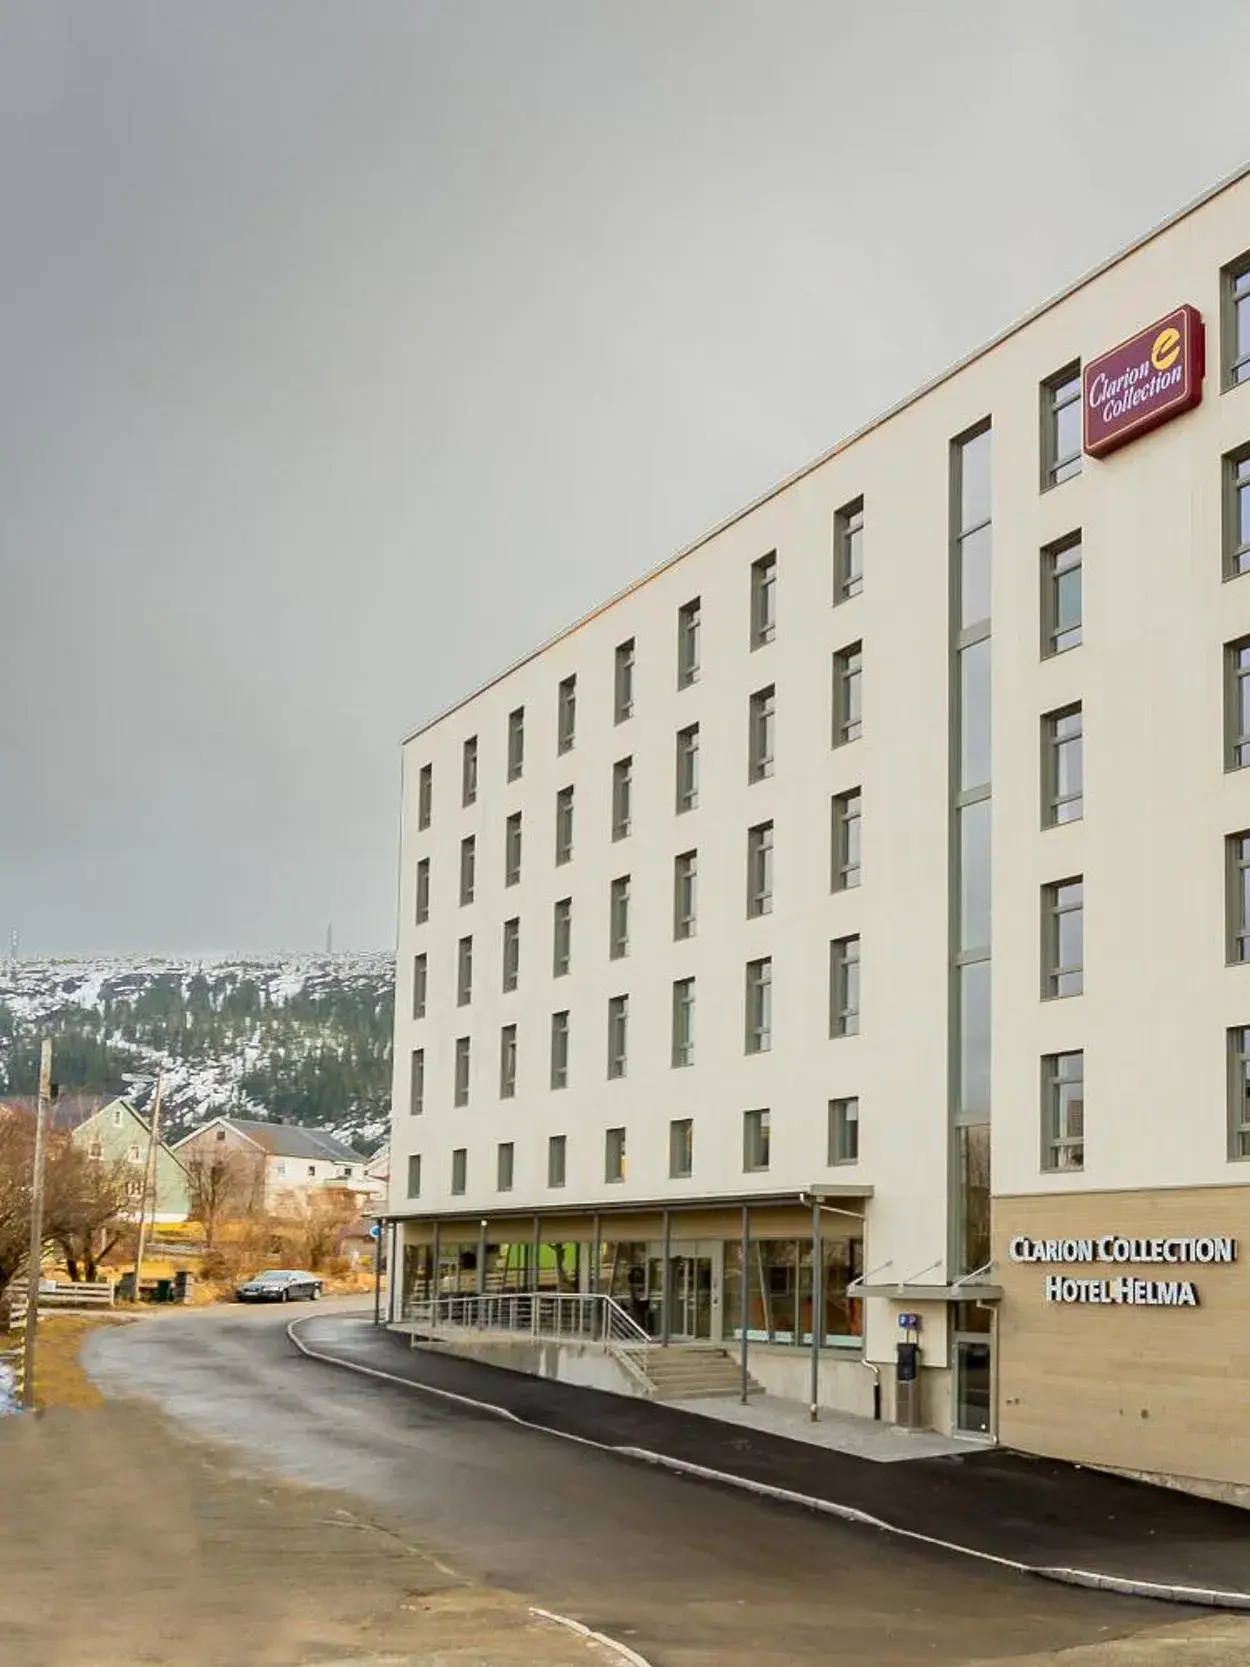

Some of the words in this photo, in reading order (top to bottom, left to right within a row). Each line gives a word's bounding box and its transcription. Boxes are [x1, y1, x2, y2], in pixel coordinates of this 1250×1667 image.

[1089, 360, 1149, 408] Clarion
[1102, 365, 1182, 422] Collection
[1010, 1235, 1093, 1262] CLARION
[1096, 1235, 1236, 1263] COLLECTION
[1046, 1275, 1112, 1303] HOTEL
[1114, 1276, 1196, 1306] HELMA
